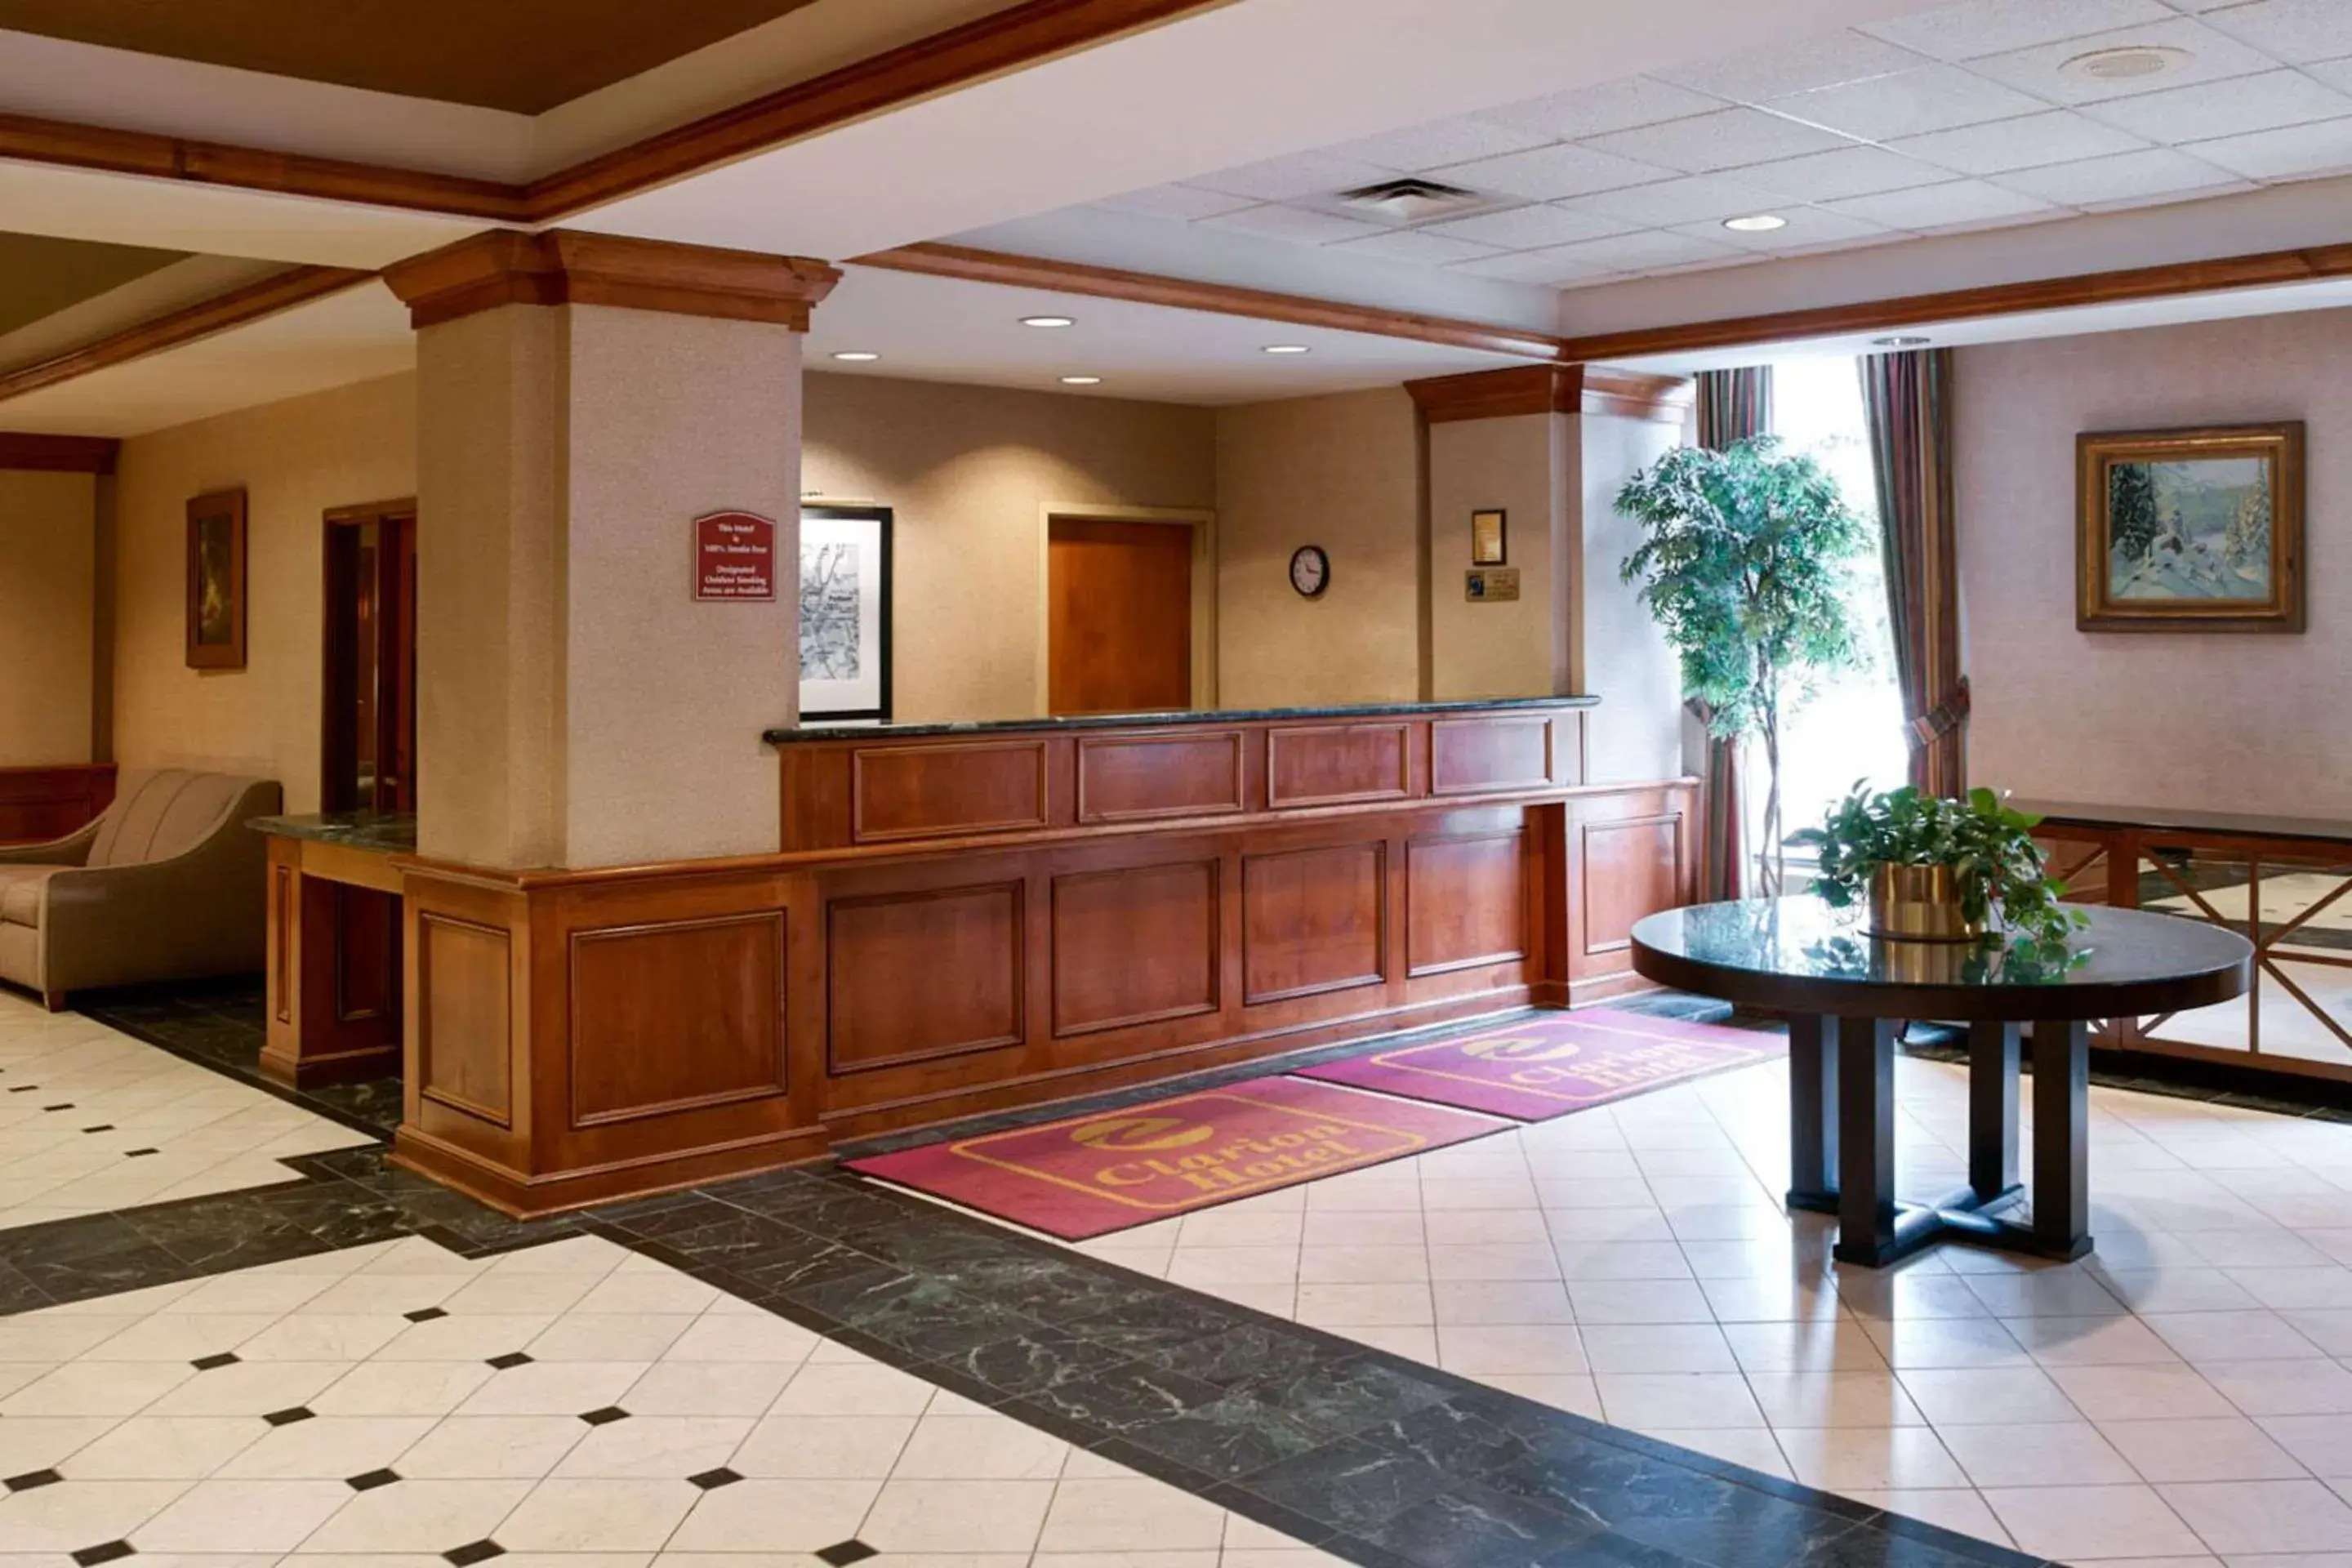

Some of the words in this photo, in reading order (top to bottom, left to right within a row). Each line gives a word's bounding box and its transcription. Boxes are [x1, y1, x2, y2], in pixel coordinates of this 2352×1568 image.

[1511, 1042, 1691, 1085] Clarion
[1095, 1125, 1348, 1186] Clarion
[1181, 1141, 1361, 1191] Hotel
